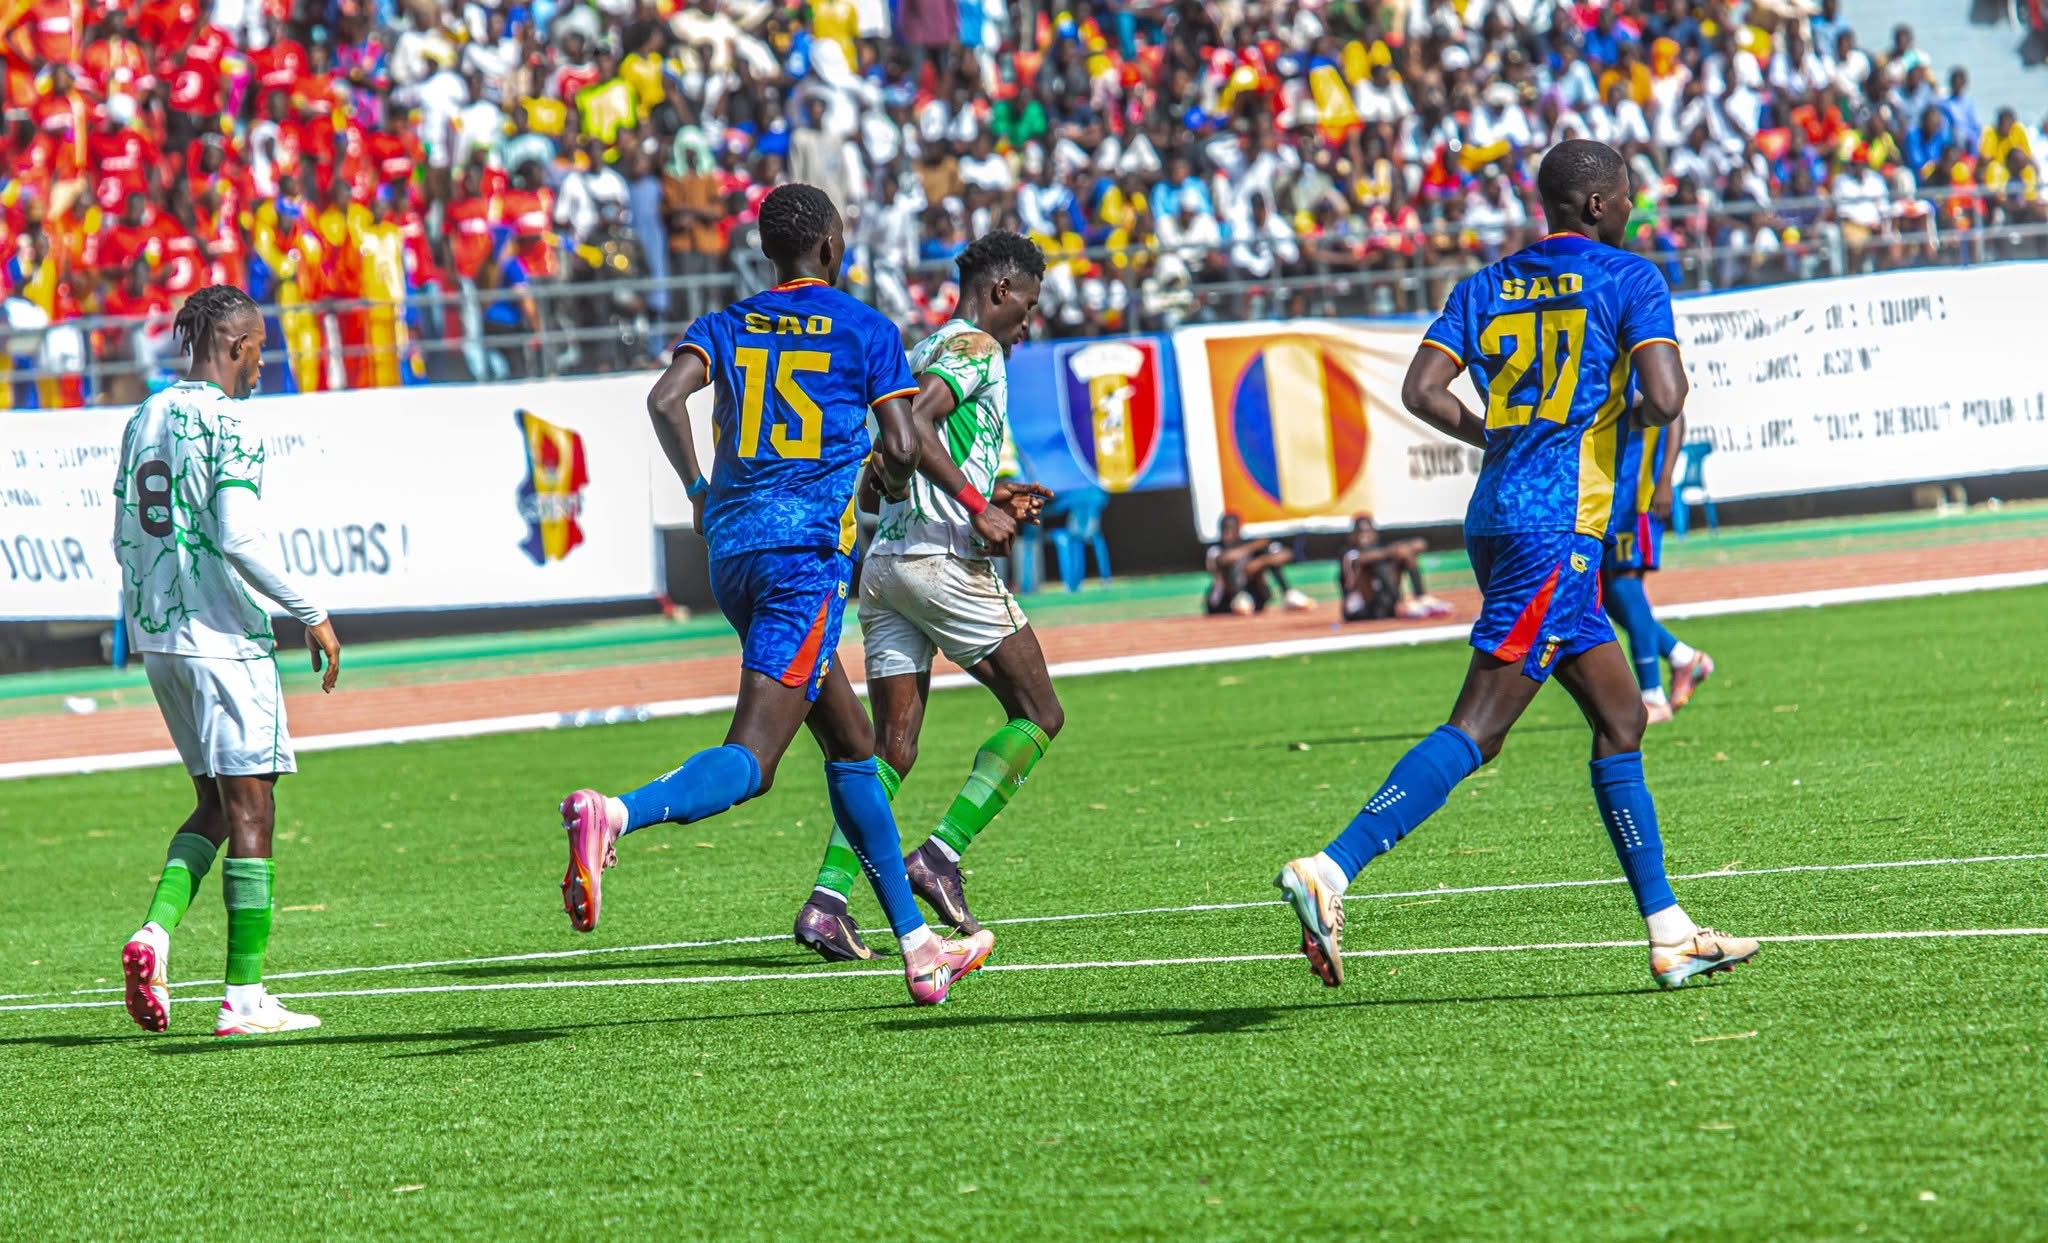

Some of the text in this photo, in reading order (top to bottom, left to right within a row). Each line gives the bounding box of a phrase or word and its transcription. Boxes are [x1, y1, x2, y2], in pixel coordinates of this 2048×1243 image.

[745, 313, 832, 336] SAO
[1499, 272, 1583, 300] SAO
[735, 346, 831, 459] 15
[1480, 308, 1587, 430] 20
[136, 459, 173, 538] 8
